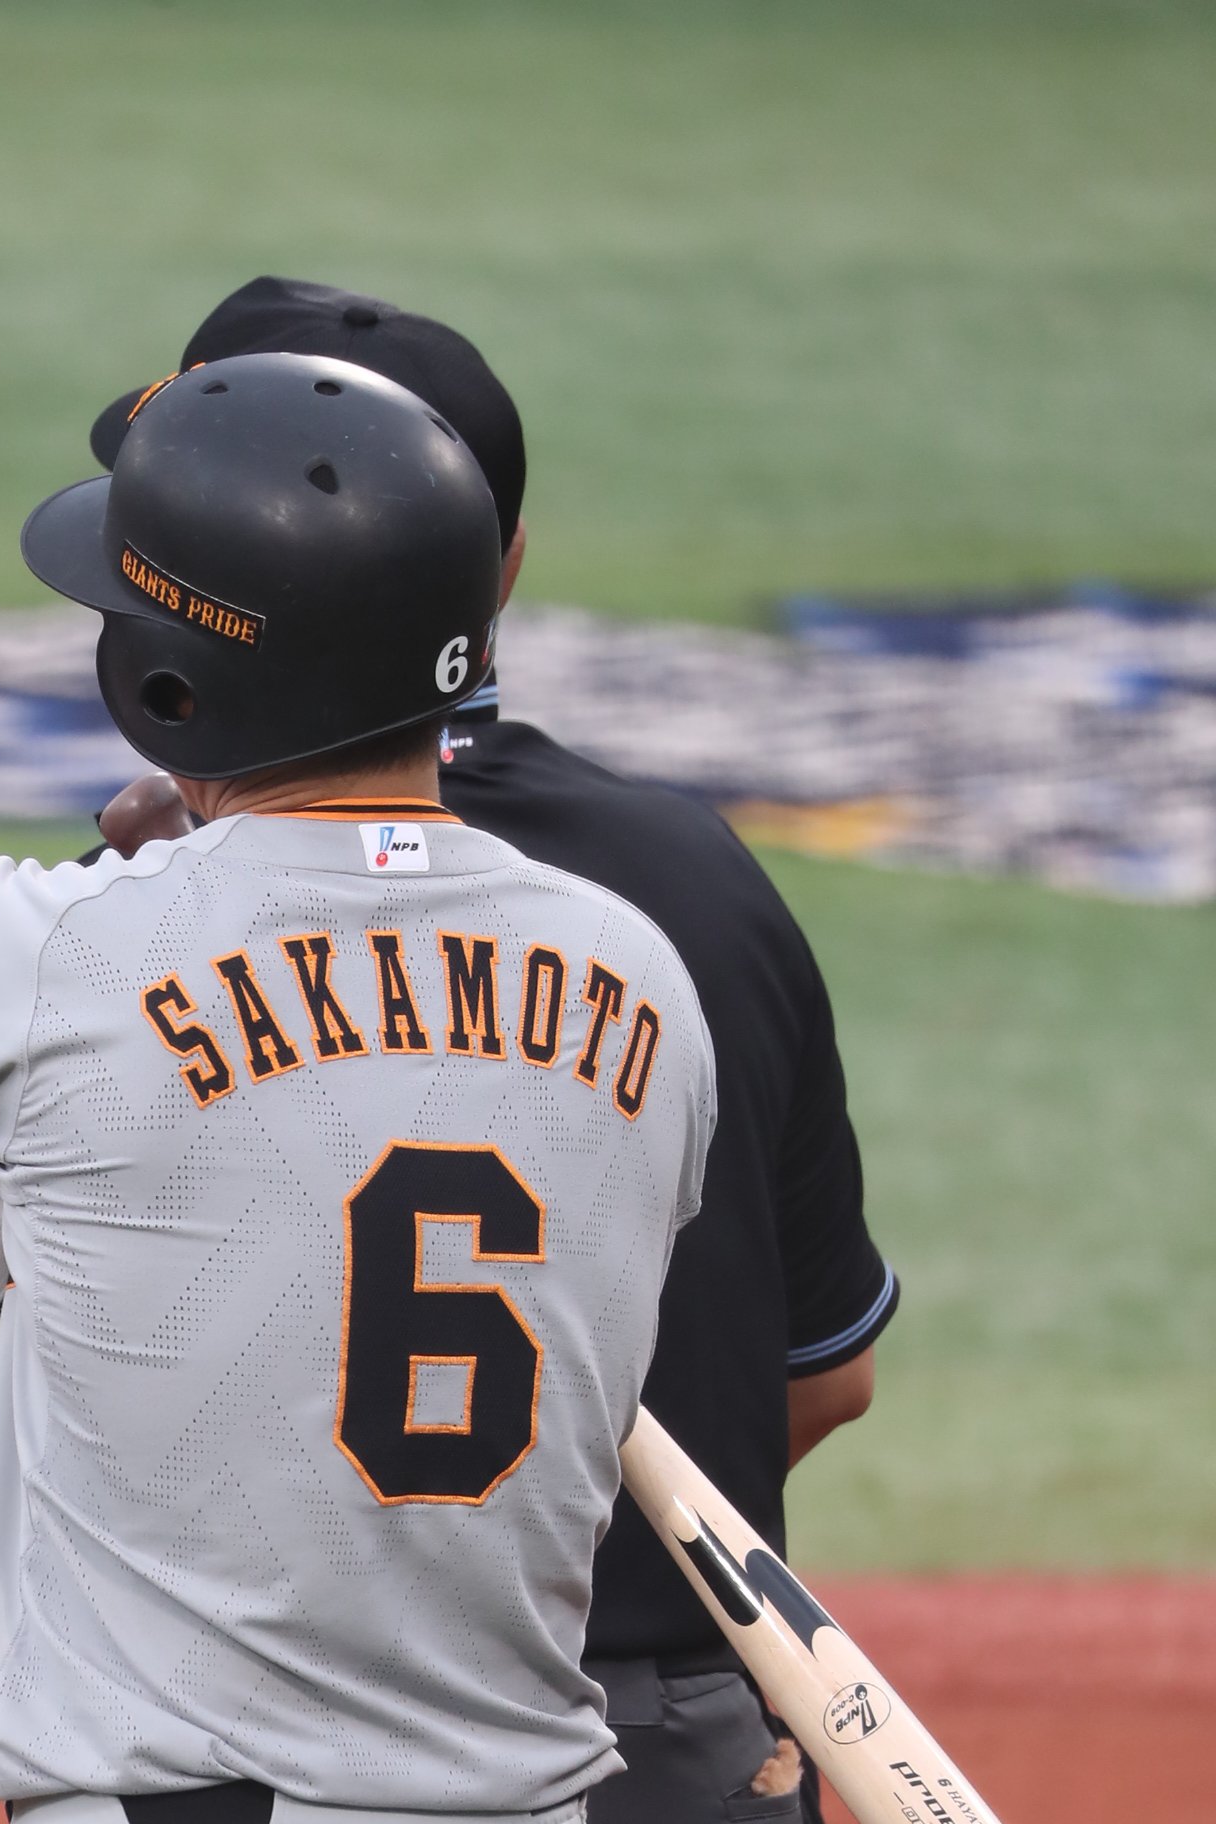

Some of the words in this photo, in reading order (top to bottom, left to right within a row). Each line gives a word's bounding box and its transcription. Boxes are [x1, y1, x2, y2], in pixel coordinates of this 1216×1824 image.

[122, 550, 181, 610] GIANTS
[186, 596, 257, 644] PRIDE
[435, 635, 469, 693] 6
[390, 842, 419, 851] NPB
[140, 929, 662, 1121] SAKAMOTO
[334, 1138, 546, 1506] 6
[836, 1705, 860, 1733] NPB
[937, 1778, 952, 1788] 6
